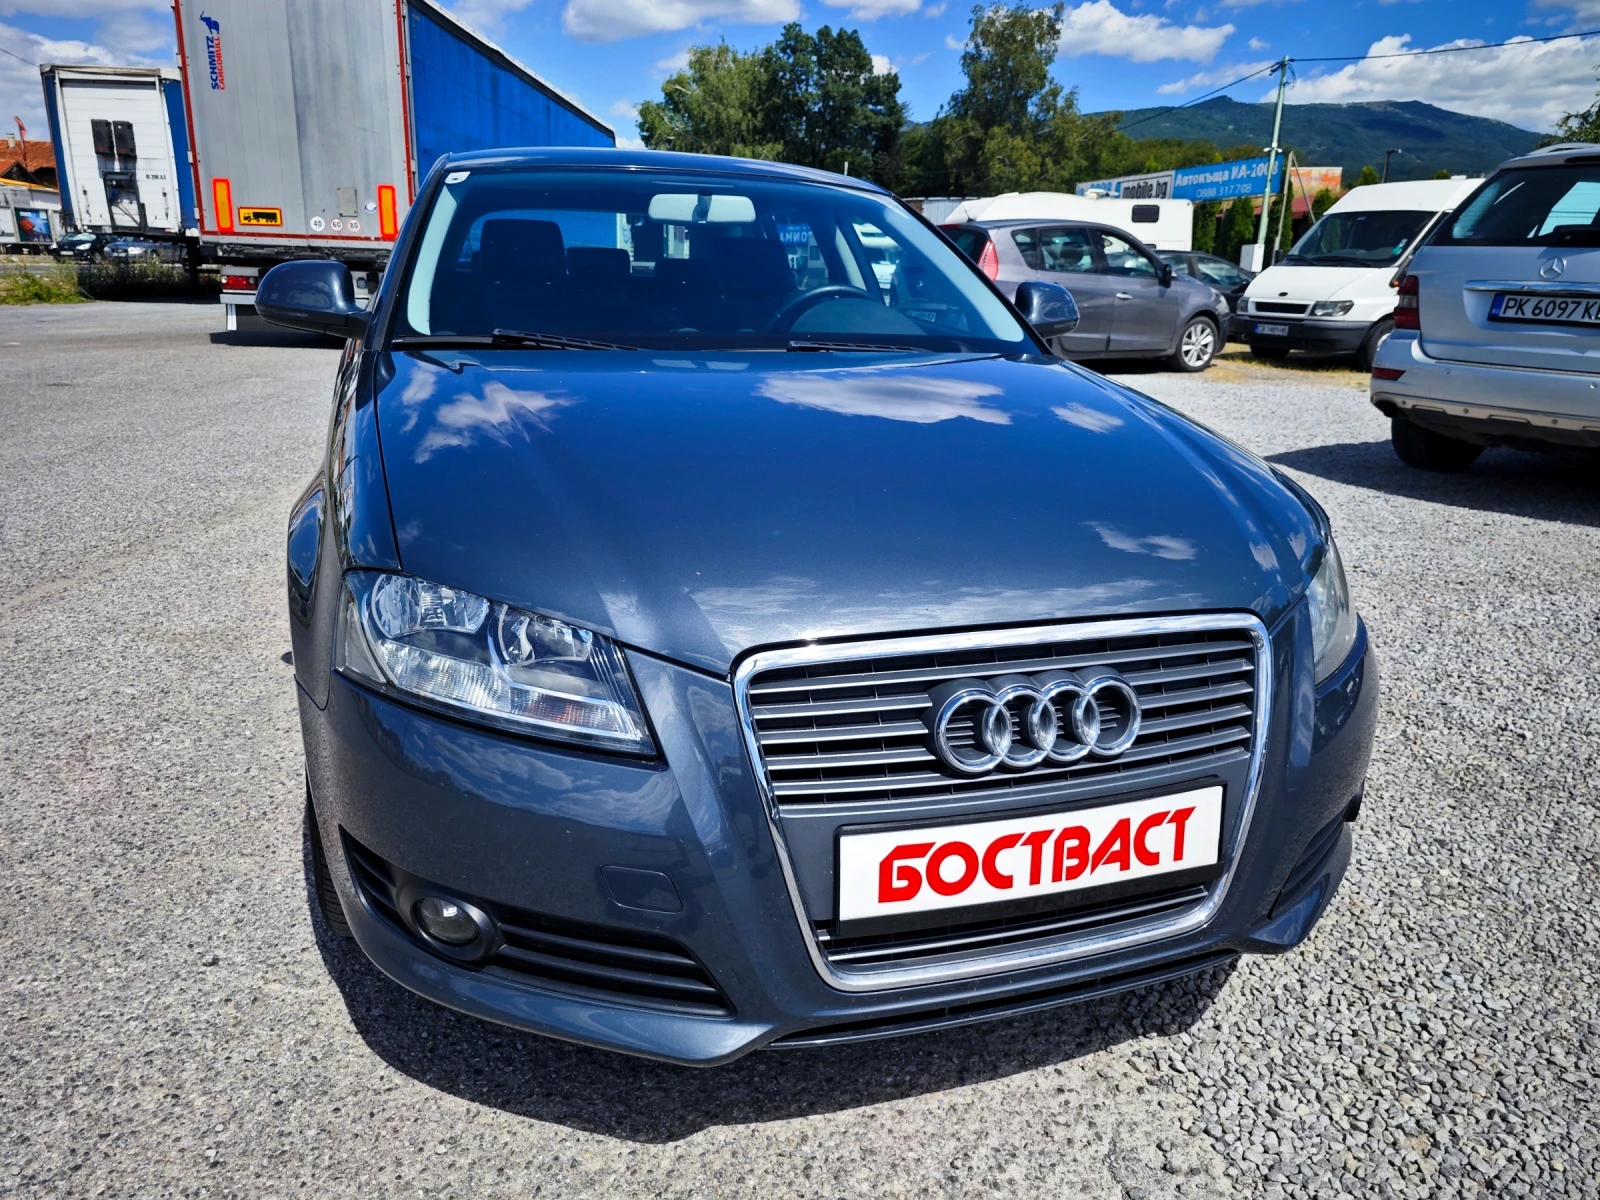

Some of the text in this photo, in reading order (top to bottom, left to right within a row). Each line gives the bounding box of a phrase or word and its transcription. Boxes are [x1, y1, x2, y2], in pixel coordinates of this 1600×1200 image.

[206, 35, 219, 90] SCHMITZ
[214, 35, 225, 91] CARGOBULL
[1175, 170, 1229, 187] Автокъща
[1196, 183, 1252, 198] 0888 317 708
[1502, 297, 1600, 320] PK 6097 K
[878, 806, 1197, 904] БОСТВАСТ
